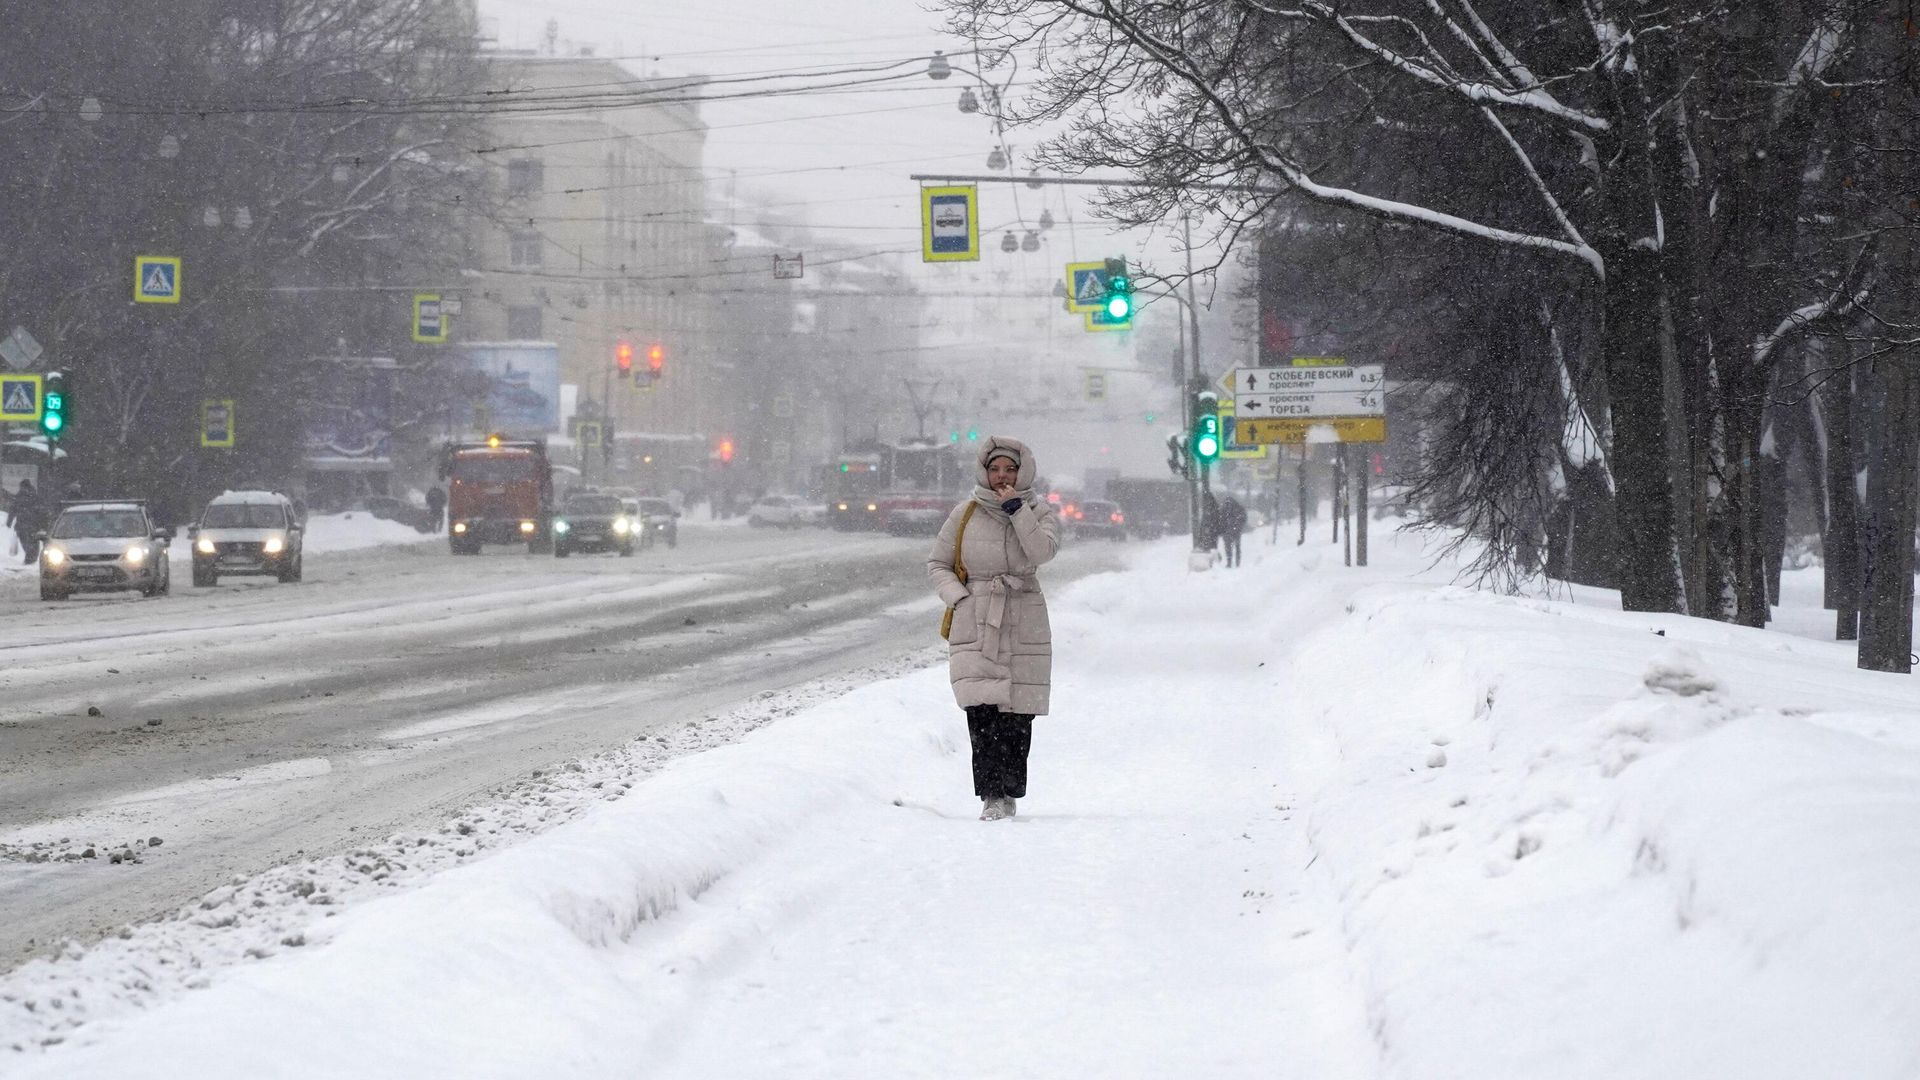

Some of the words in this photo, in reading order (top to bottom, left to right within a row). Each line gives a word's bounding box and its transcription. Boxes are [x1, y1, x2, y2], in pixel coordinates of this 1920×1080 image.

[1269, 369, 1354, 381] СКОБЕЛЕВСКИЙ
[1269, 381, 1315, 390] проспект
[1269, 395, 1315, 404] проспект
[1269, 405, 1310, 414] ТОРЕЗА
[1207, 420, 1216, 434] 9
